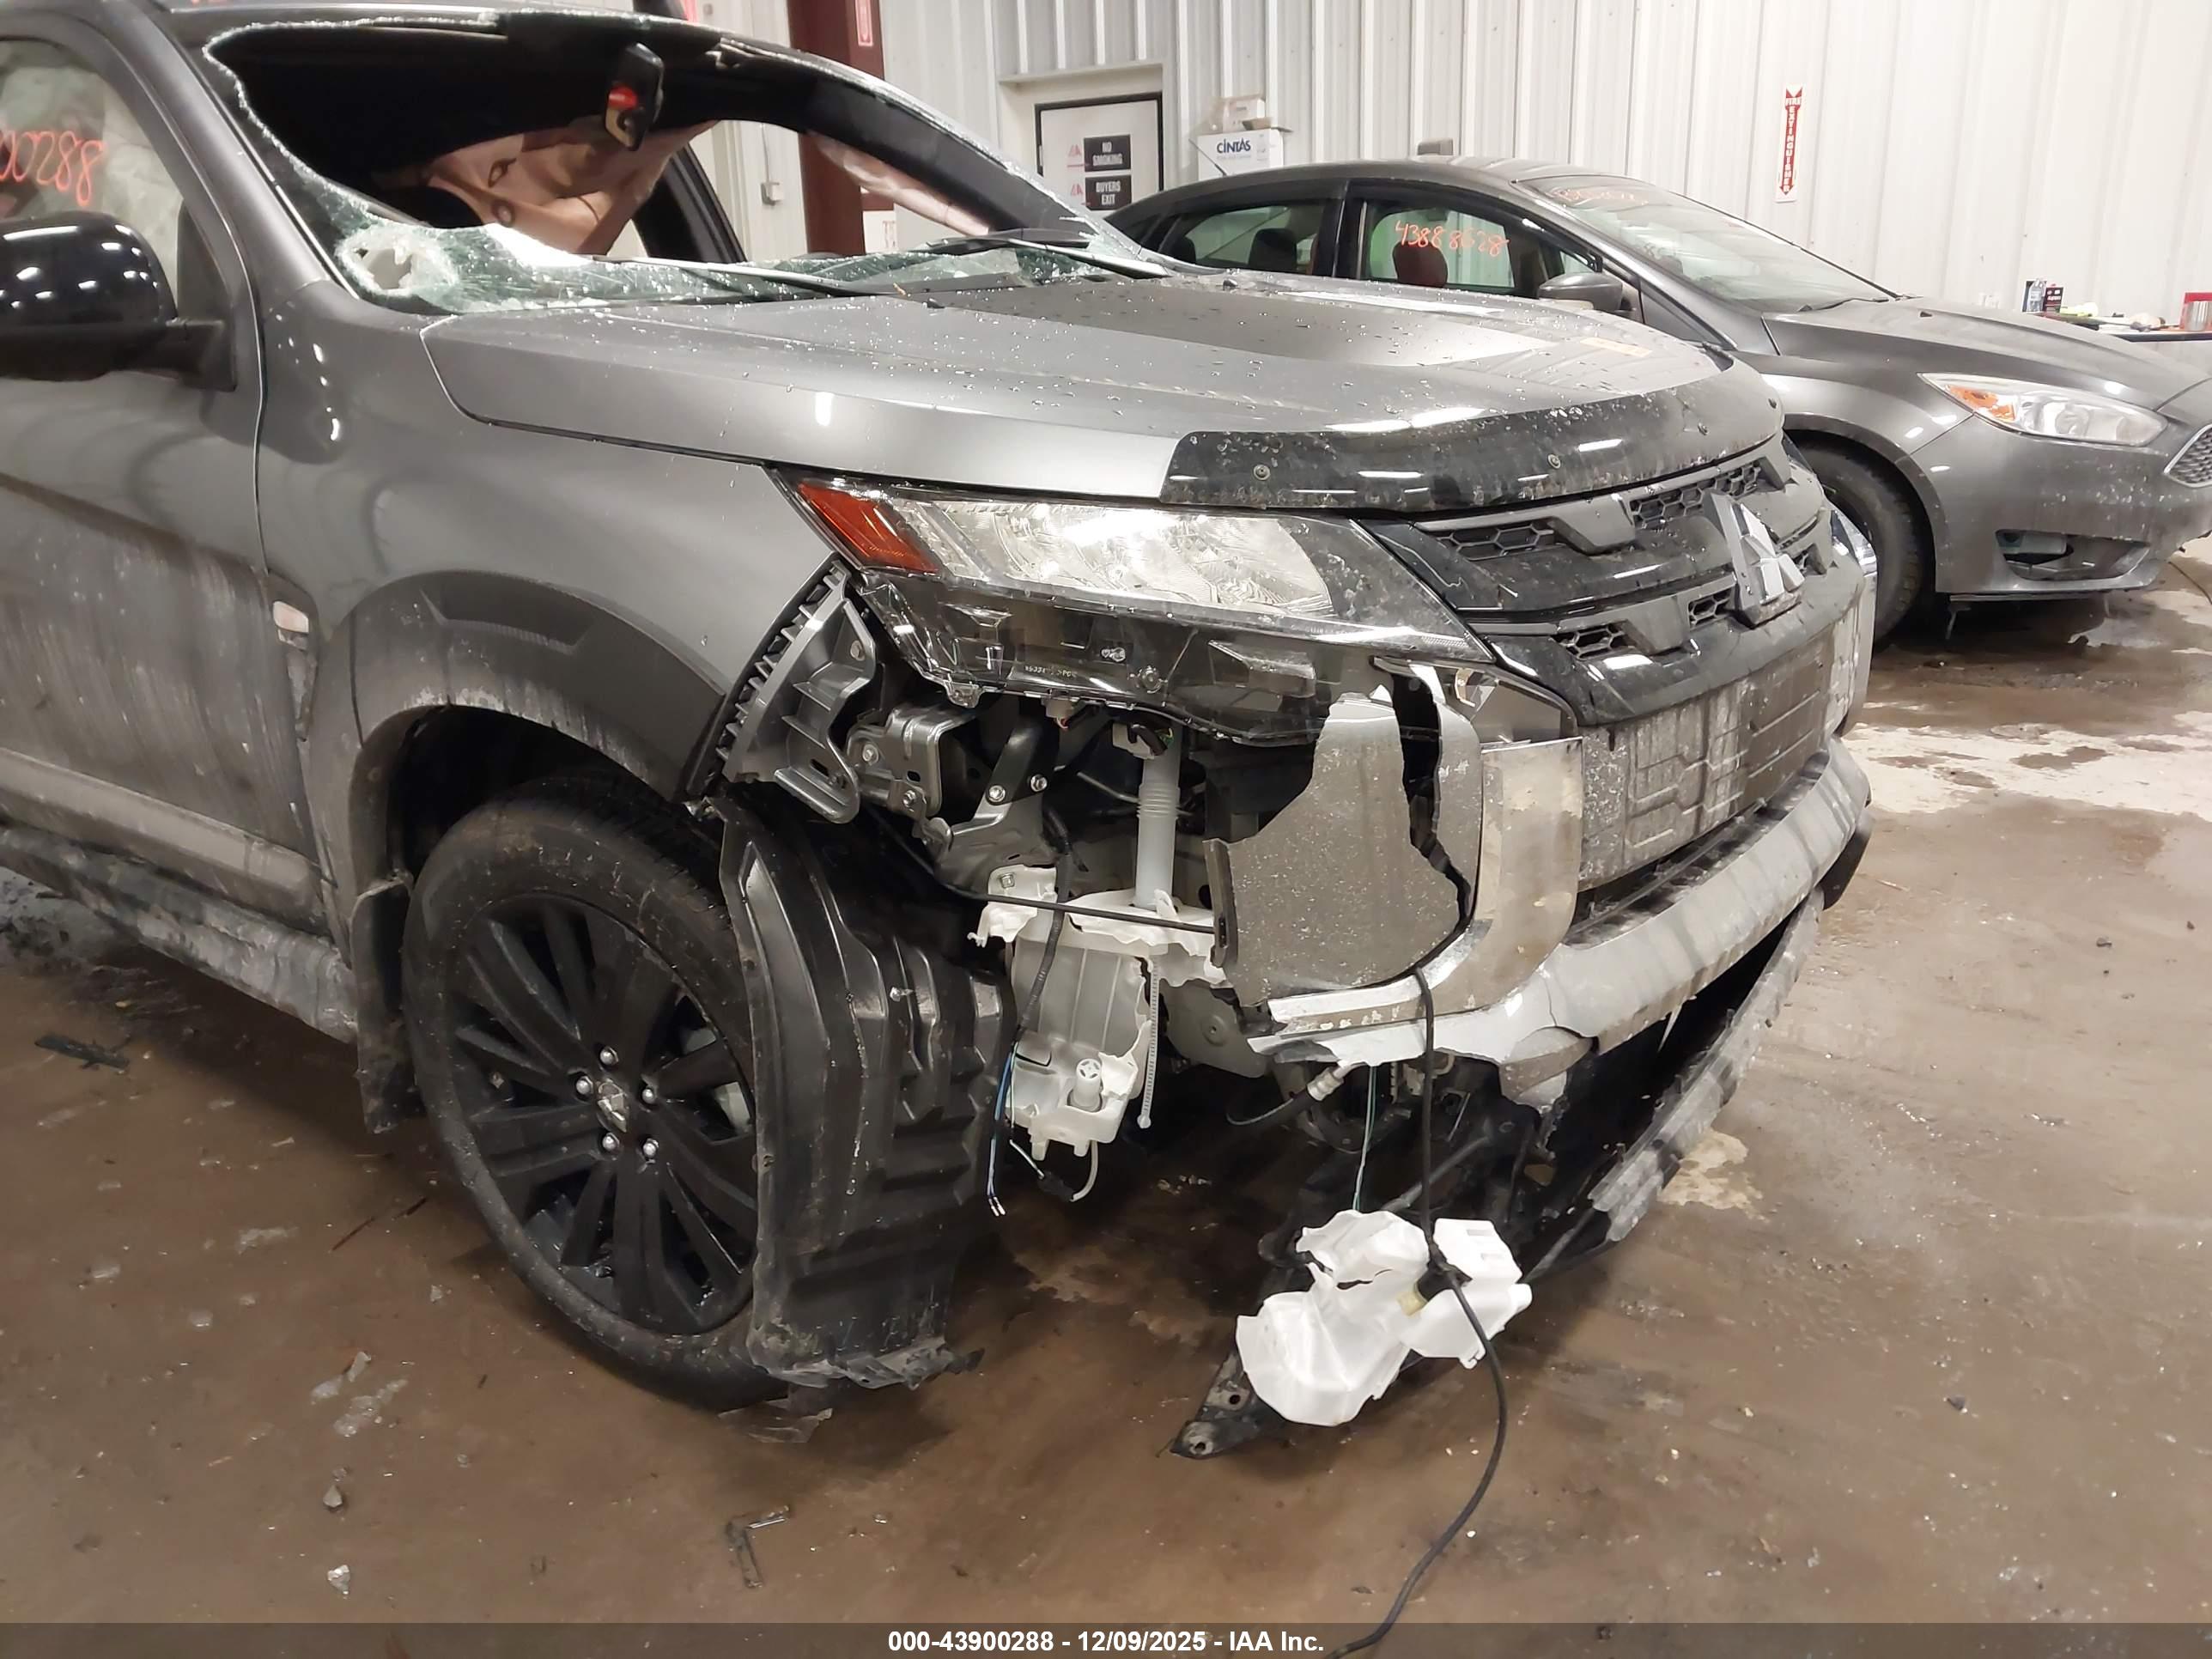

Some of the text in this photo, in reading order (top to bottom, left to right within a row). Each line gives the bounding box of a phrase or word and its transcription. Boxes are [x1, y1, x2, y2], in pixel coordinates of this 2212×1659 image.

[1102, 141, 1113, 153] NO
[1217, 137, 1251, 154] CINTAS
[1092, 153, 1123, 167] SMOKING
[1096, 180, 1121, 193] BUYERS
[1101, 194, 1115, 205] EXIT
